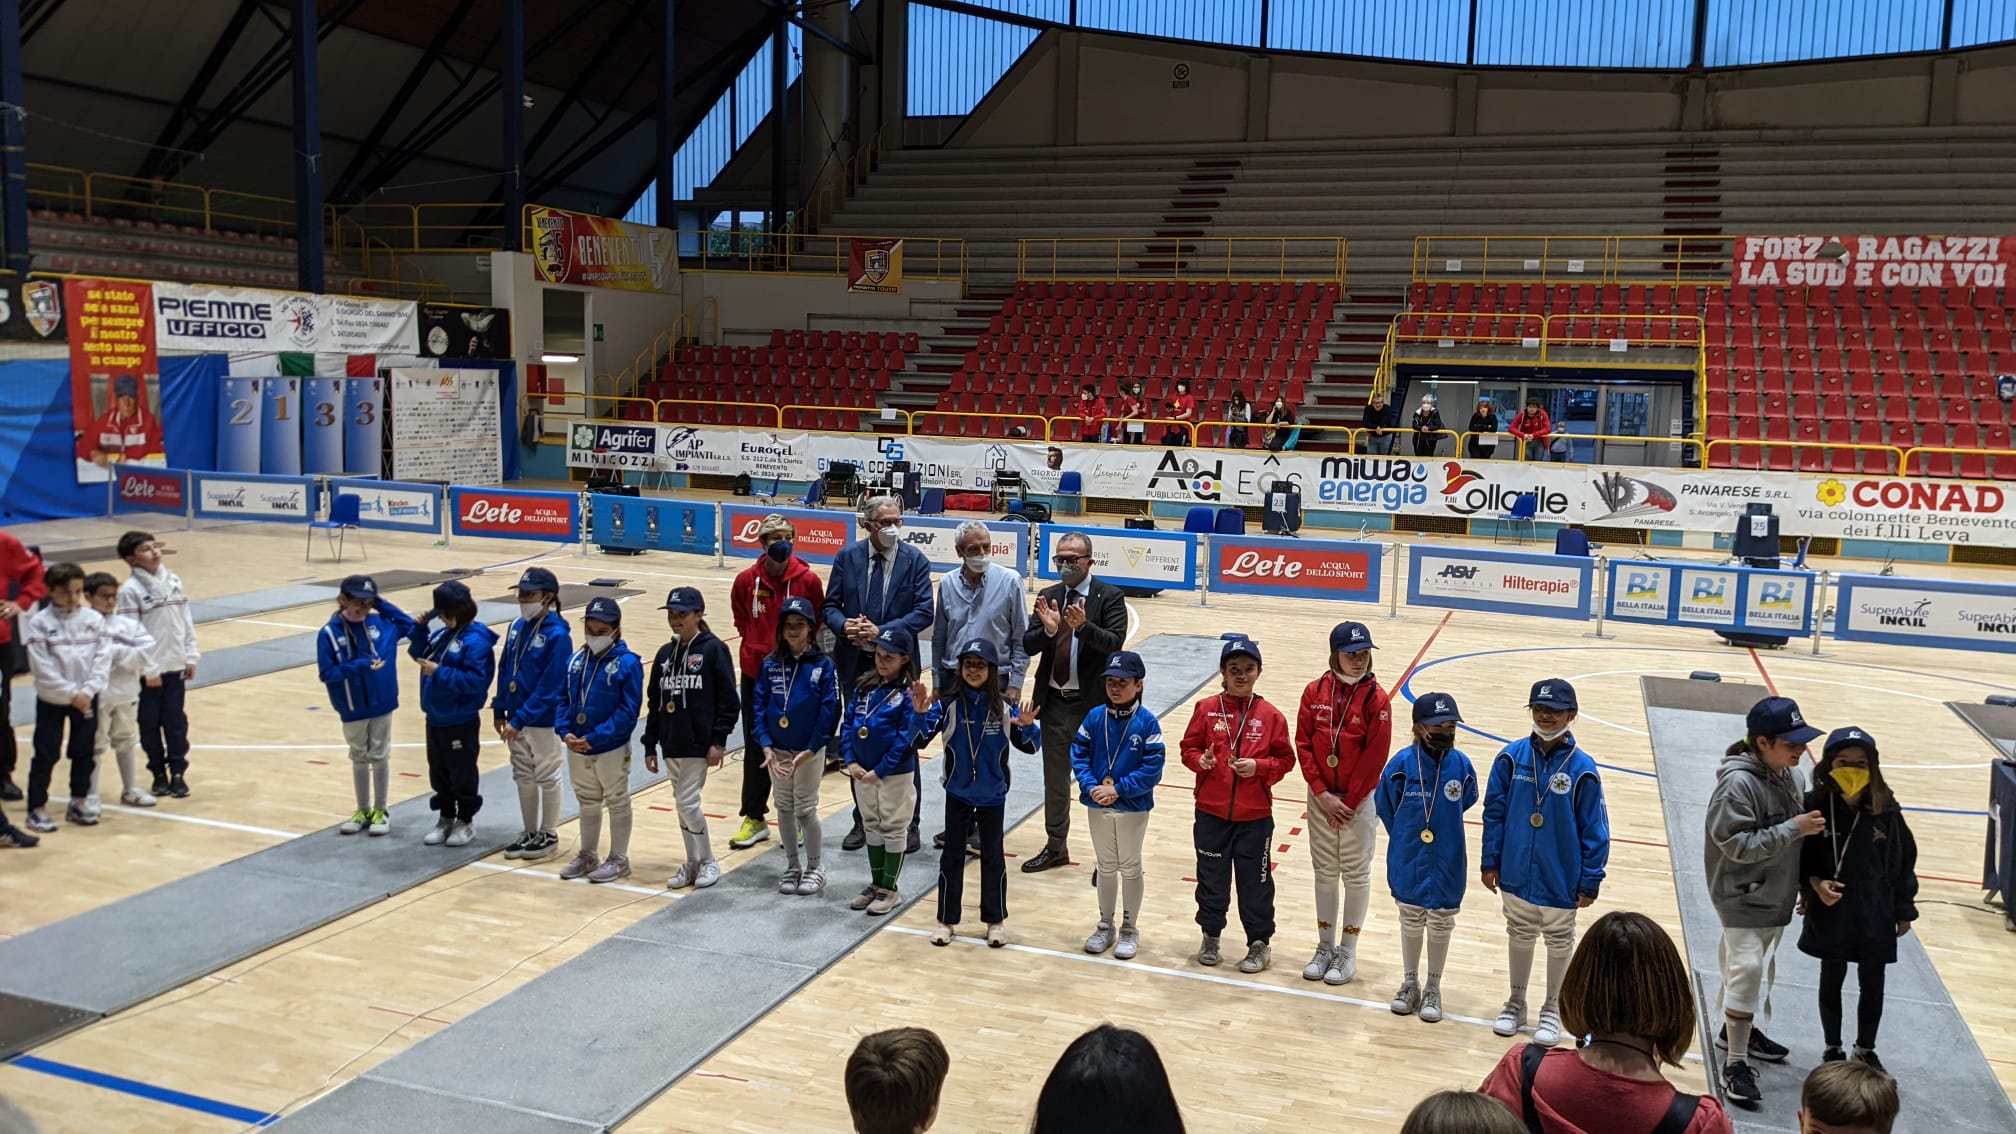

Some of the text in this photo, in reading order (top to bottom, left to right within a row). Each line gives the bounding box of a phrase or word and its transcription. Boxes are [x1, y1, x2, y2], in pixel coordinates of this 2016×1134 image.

[1744, 236, 2001, 261] FORZ RAGAZZI
[1738, 262, 2007, 288] LA SUD E CON VOI
[104, 289, 136, 302] stato
[110, 303, 140, 314] sarai
[158, 297, 272, 321] PIEMME
[101, 317, 145, 330] sempre
[168, 320, 264, 337] UFFICIO
[100, 329, 138, 341] nostro
[114, 343, 146, 353] uomo
[229, 400, 254, 426] 2
[274, 395, 291, 421] 1
[315, 401, 336, 427] 3
[355, 401, 375, 426] 3
[599, 429, 653, 451] Agrifer
[688, 439, 704, 450] AP
[571, 452, 656, 468] MINICOZZI
[675, 449, 713, 460] IMPIANTI
[755, 463, 788, 471] BENEVENTO
[1320, 456, 1412, 482] miwa
[121, 476, 155, 499] Lete
[948, 478, 963, 487] (CE)
[1319, 480, 1428, 512] energia
[1681, 484, 1792, 499] PANARESE S.R.L.
[1852, 480, 2005, 514] CONAD
[1273, 498, 1284, 507] 23
[1706, 501, 1720, 509] Via
[461, 499, 523, 525] Lete
[534, 507, 558, 517] ACQUA
[1697, 509, 1732, 518] Arcangelo
[1798, 508, 1824, 520] via
[1828, 508, 1922, 525] colonnette
[523, 515, 569, 525] DELLO SPORT
[1633, 518, 1675, 527] PANARESE
[1753, 521, 1766, 531] 25
[808, 529, 833, 538] ACQUA
[1843, 524, 1875, 538] dei
[1918, 525, 1971, 542] Leva
[798, 535, 845, 546] DELLO SPORT
[1146, 547, 1152, 555] A
[1145, 555, 1180, 564] DIFFERENT
[1222, 551, 1303, 579] Lete
[1319, 561, 1351, 570] ACQUA
[1163, 564, 1180, 572] VIBE
[1305, 568, 1365, 580] DELLO SPORT
[1616, 601, 1665, 611] BELLA ITALIA
[1681, 606, 1732, 617] BELLA ITALIA
[1748, 611, 1773, 620] BELLA
[1774, 613, 1800, 622] ITALIA
[660, 675, 703, 689] CASERTA
